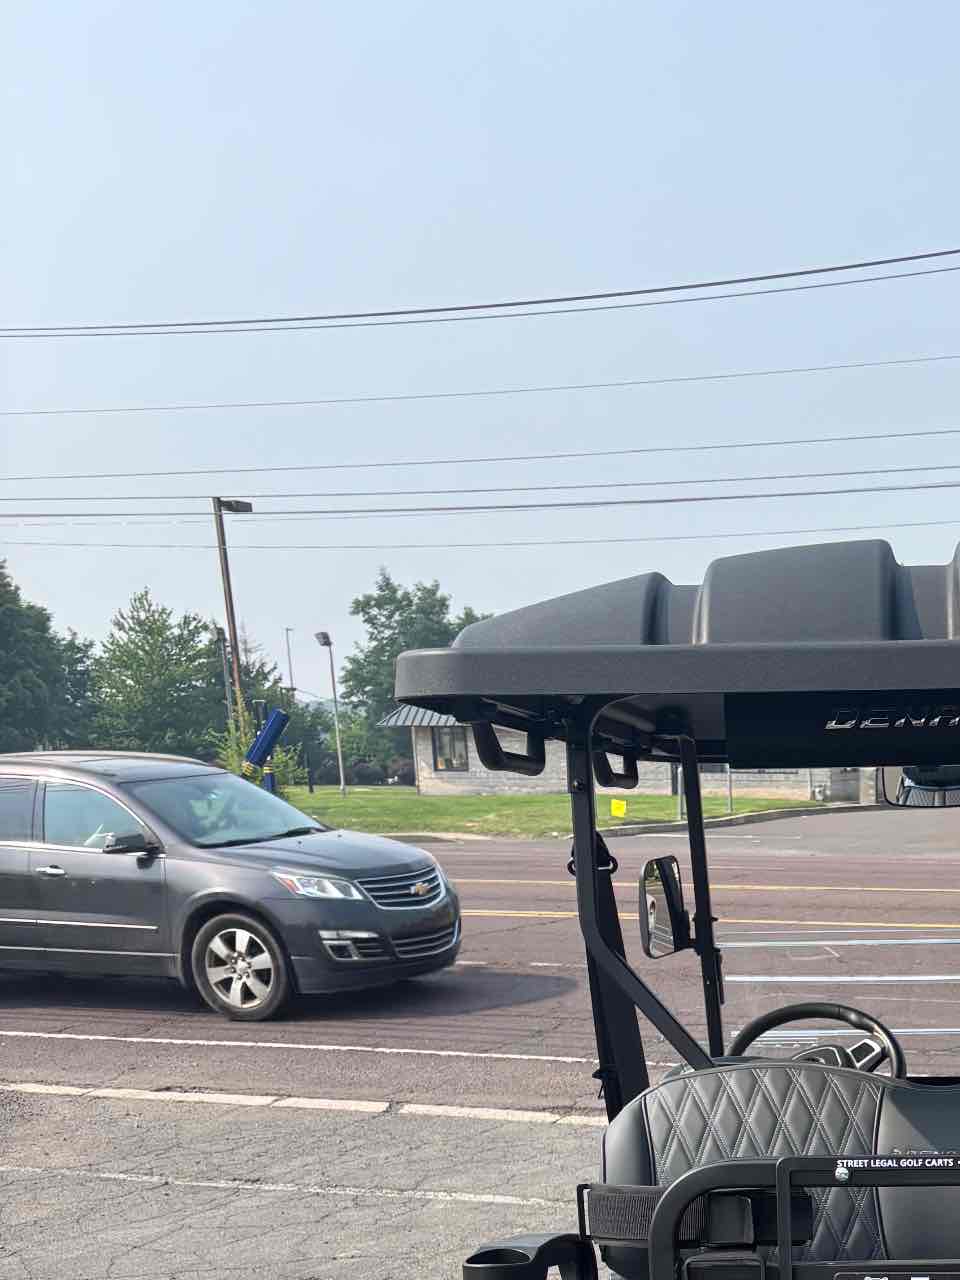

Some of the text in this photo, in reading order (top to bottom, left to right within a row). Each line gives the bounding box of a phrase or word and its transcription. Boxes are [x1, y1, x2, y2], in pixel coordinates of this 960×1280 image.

[836, 1159, 869, 1168] STREET
[871, 1159, 898, 1168] LEGAL
[900, 1159, 923, 1167] GOLF
[925, 1158, 954, 1167] CARTS
